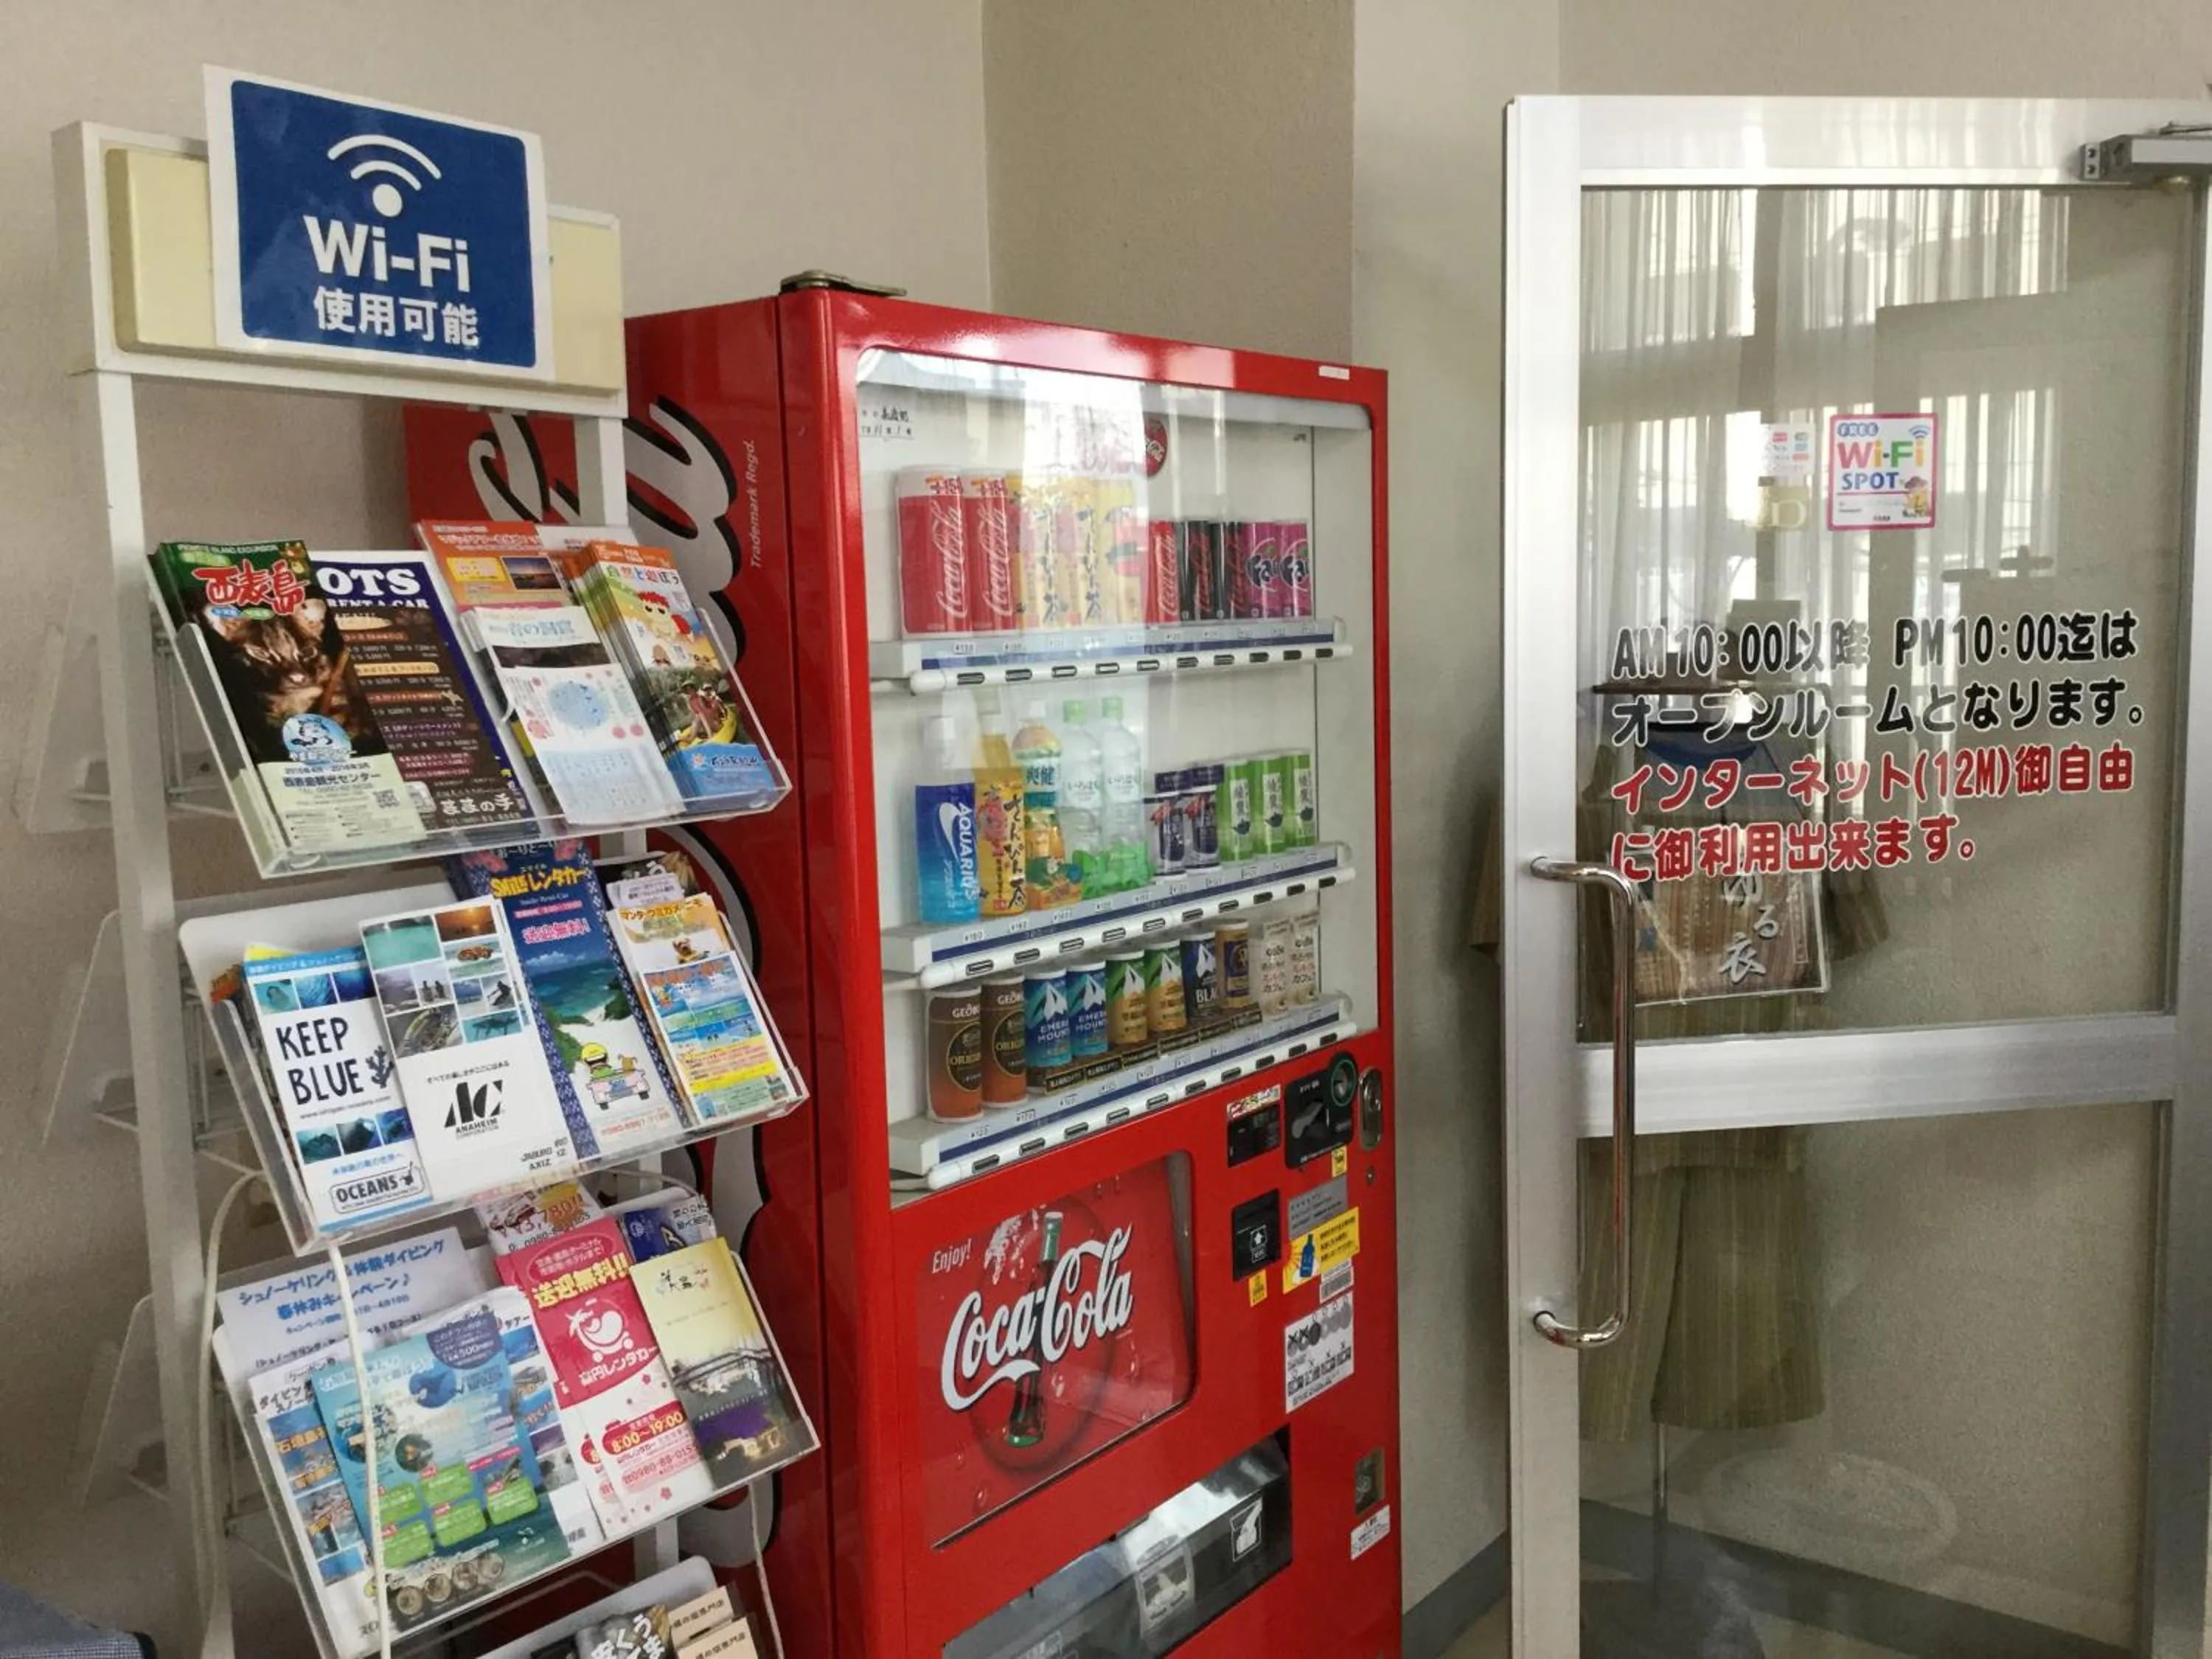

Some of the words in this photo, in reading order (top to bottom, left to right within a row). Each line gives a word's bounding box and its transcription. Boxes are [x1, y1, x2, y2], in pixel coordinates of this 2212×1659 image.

[302, 215, 470, 293] Wi-Fi
[313, 286, 480, 347] 使用可能
[1837, 422, 1878, 437] FREE
[1843, 472, 1899, 490] SPOT
[747, 487, 761, 567] Trademark
[192, 558, 312, 615] 西表島
[316, 567, 421, 596] OTS
[1612, 678, 2145, 747] オープンルームとなります。
[1612, 740, 2135, 815] インターネット(12M)御自由
[958, 802, 979, 902] AQUARIUS
[1612, 813, 1975, 882] に御利用出来ます。
[276, 1017, 349, 1061] KEEP
[288, 1058, 365, 1105] BLUE
[336, 1175, 398, 1203] OCEANS
[932, 1238, 972, 1274] Enjoy!
[941, 1222, 1133, 1411] Coca-Cola
